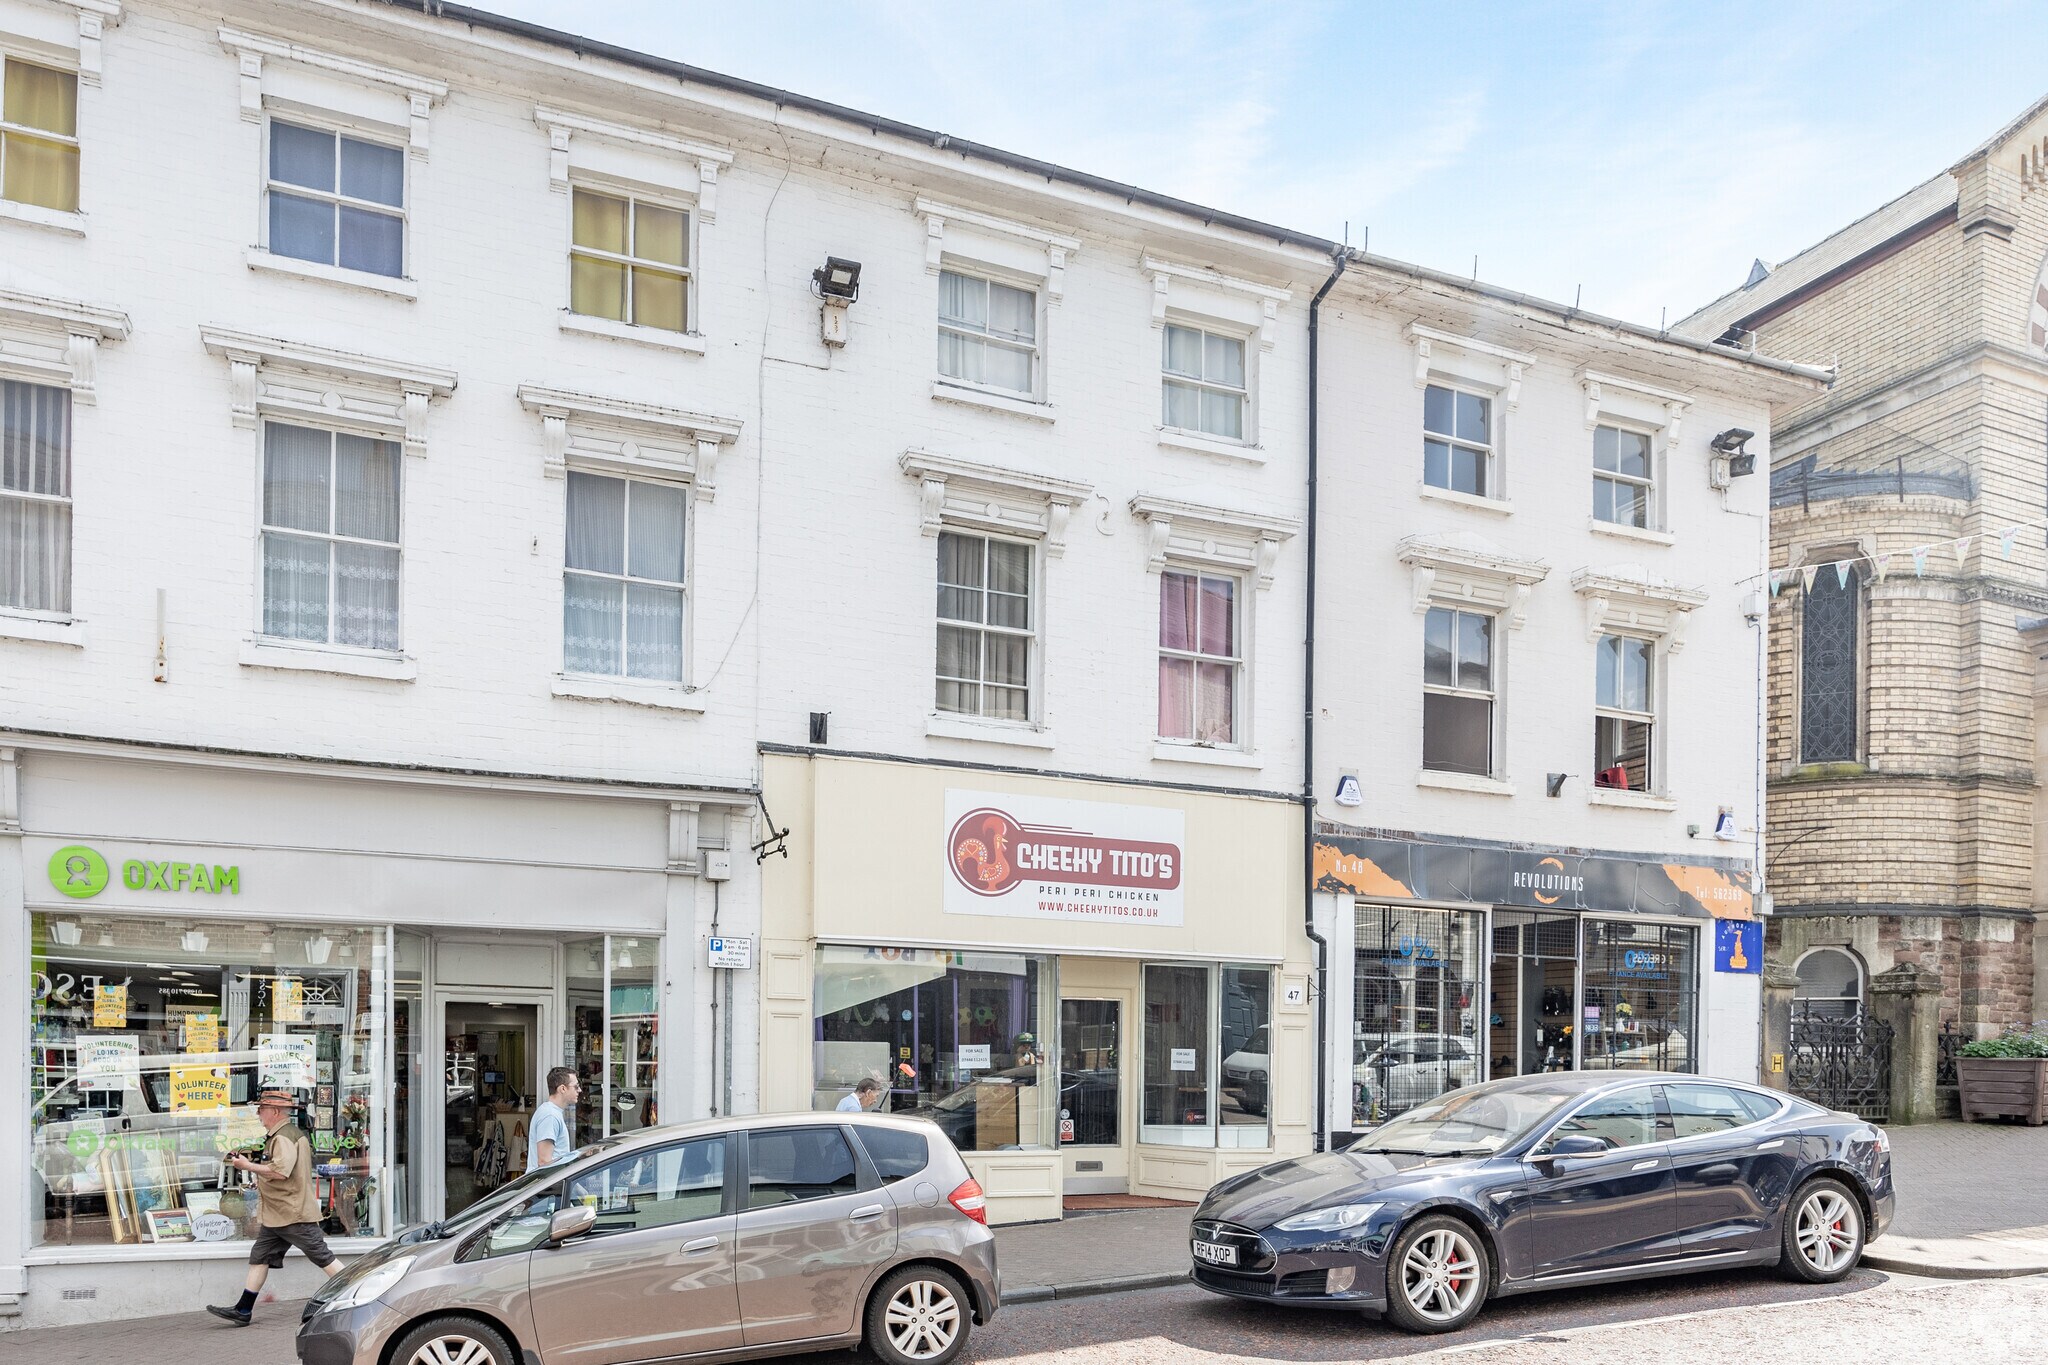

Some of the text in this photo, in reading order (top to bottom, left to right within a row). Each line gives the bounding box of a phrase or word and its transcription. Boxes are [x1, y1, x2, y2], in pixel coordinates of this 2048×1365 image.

[1016, 842, 1174, 879] CHEEKY TITO'S
[1335, 859, 1363, 873] No.48
[123, 859, 240, 895] OXFAM
[1513, 871, 1584, 892] REVOLUTIONS
[1039, 885, 1160, 902] PERI PERI CHICKEN
[1696, 886, 1711, 899] Tel:
[1038, 901, 1159, 917] WWW.CHEEKYTITOS.CO.UK
[713, 940, 722, 951] P
[1399, 935, 1435, 958] 0%
[1287, 990, 1300, 1000] 47
[82, 1040, 133, 1050] VOLUNTEERING
[99, 1064, 116, 1073] YOU
[1773, 1056, 1783, 1071] H
[174, 1079, 227, 1092] VOLUNTEER
[187, 1091, 214, 1100] HERE
[213, 1133, 266, 1151] Ross
[310, 1132, 356, 1154] Wye
[1196, 1242, 1231, 1262] RF14 XOP
